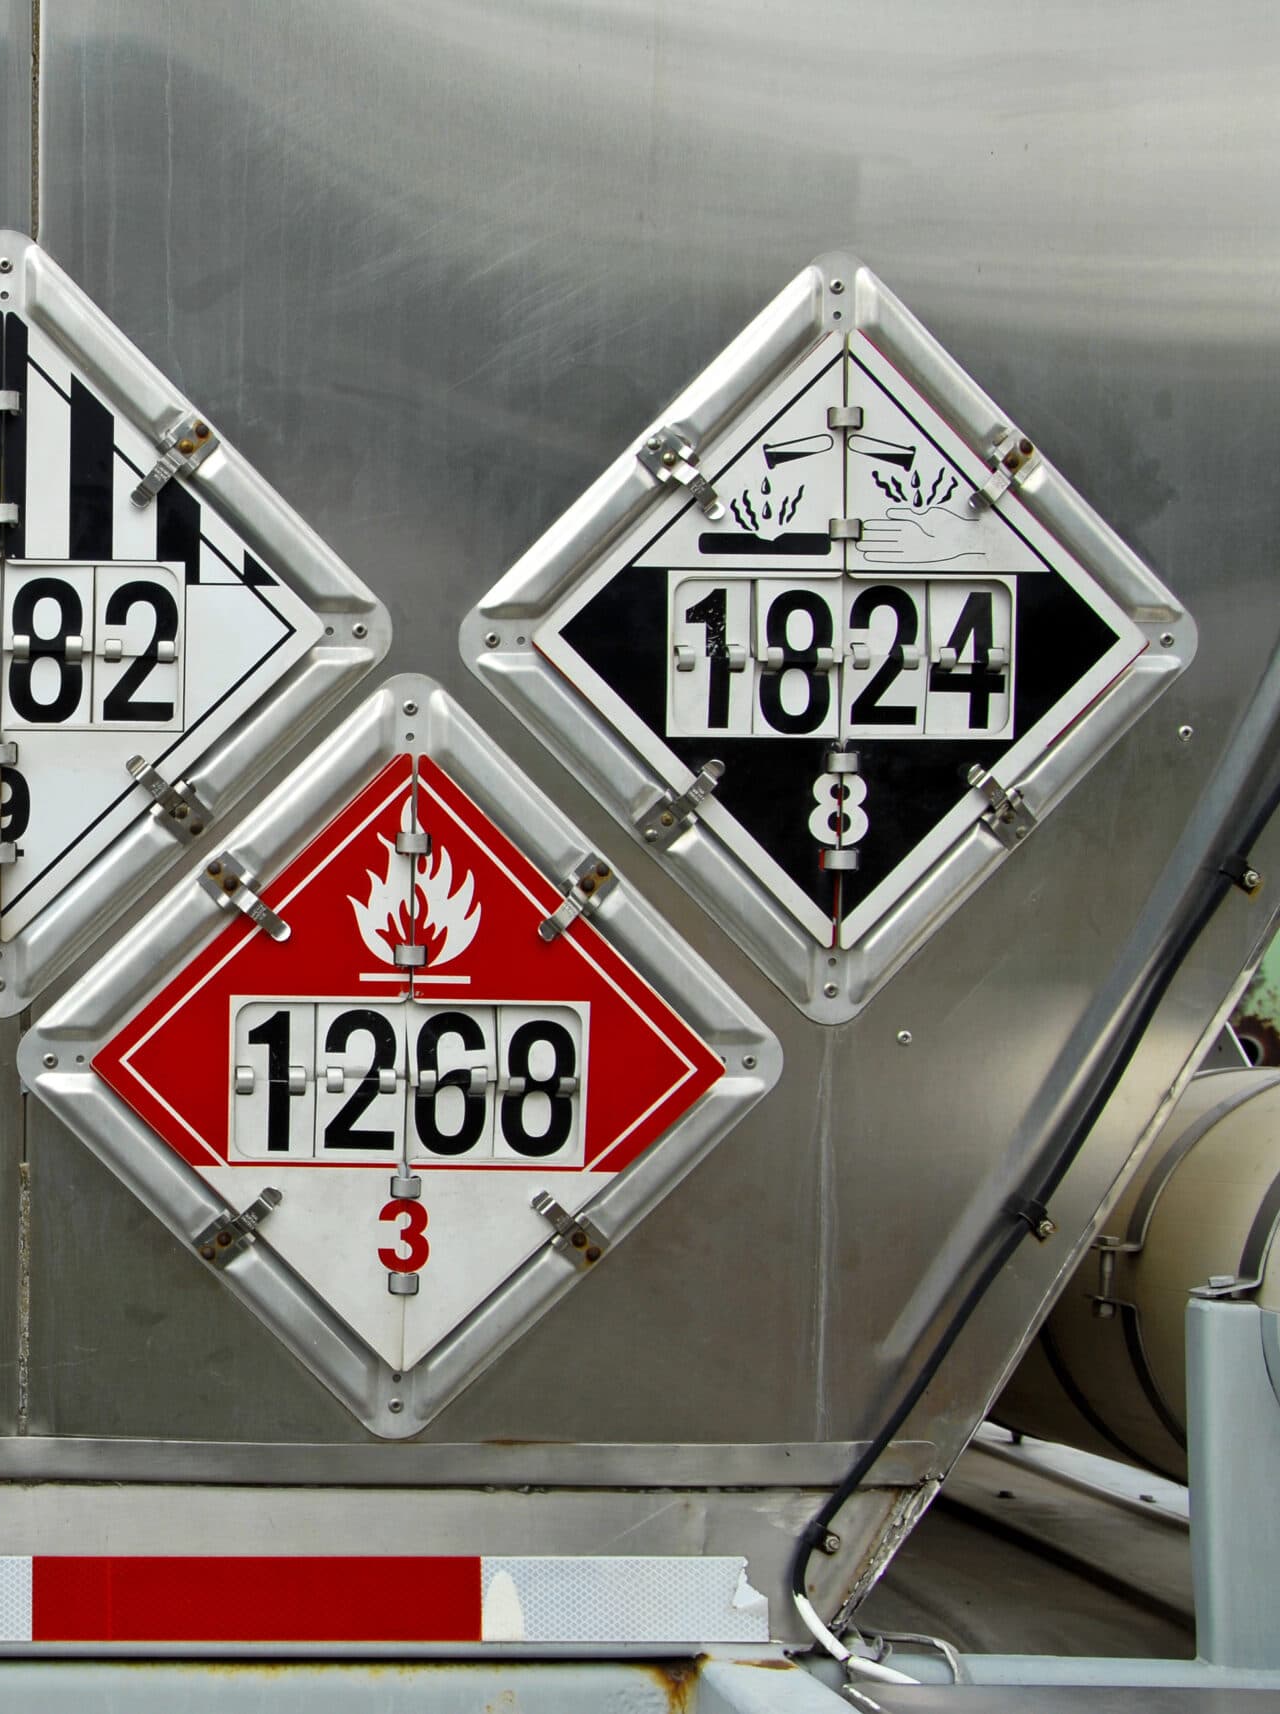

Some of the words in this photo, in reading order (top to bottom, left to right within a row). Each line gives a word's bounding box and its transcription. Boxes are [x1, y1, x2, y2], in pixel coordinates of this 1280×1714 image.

[686, 584, 1005, 735] 1824
[808, 772, 869, 847] 8
[247, 1010, 574, 1157] 1268
[378, 1200, 429, 1274] 3
